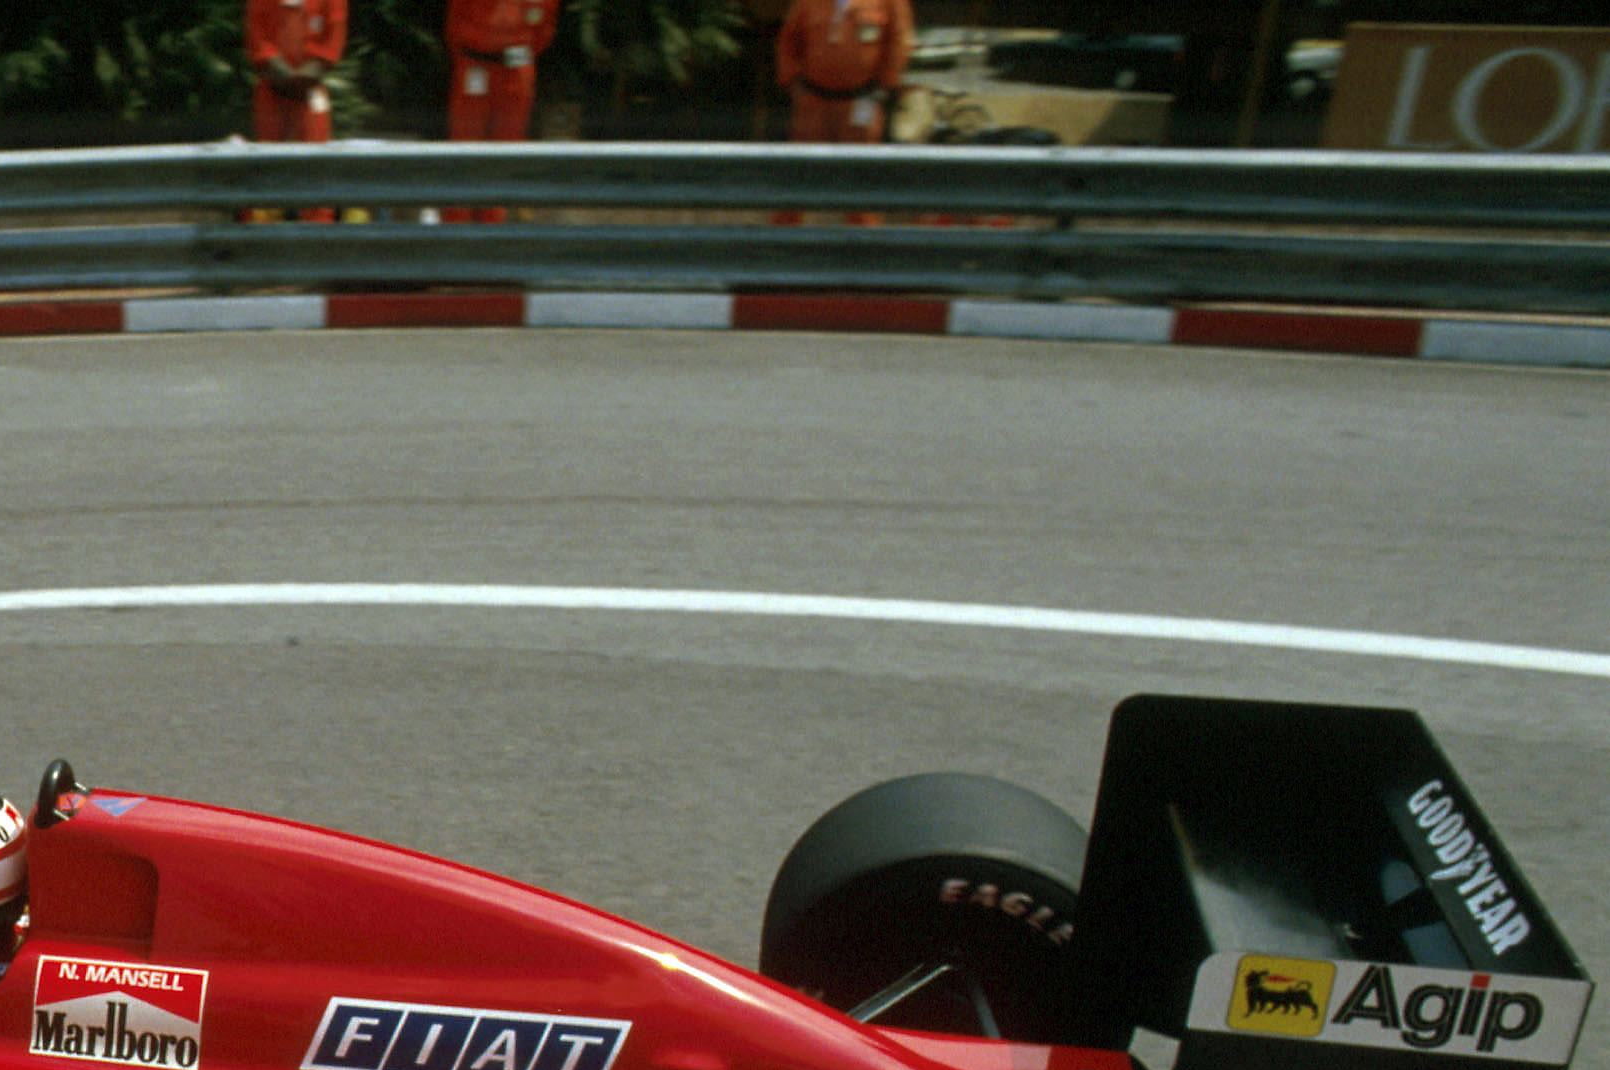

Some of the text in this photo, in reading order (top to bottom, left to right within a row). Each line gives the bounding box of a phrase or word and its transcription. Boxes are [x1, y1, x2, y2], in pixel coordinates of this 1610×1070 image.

[1406, 779, 1531, 956] GOODYEAR
[58, 962, 185, 992] N. MANSELL
[1331, 963, 1545, 1053] Agip
[33, 1000, 199, 1068] Marlboro
